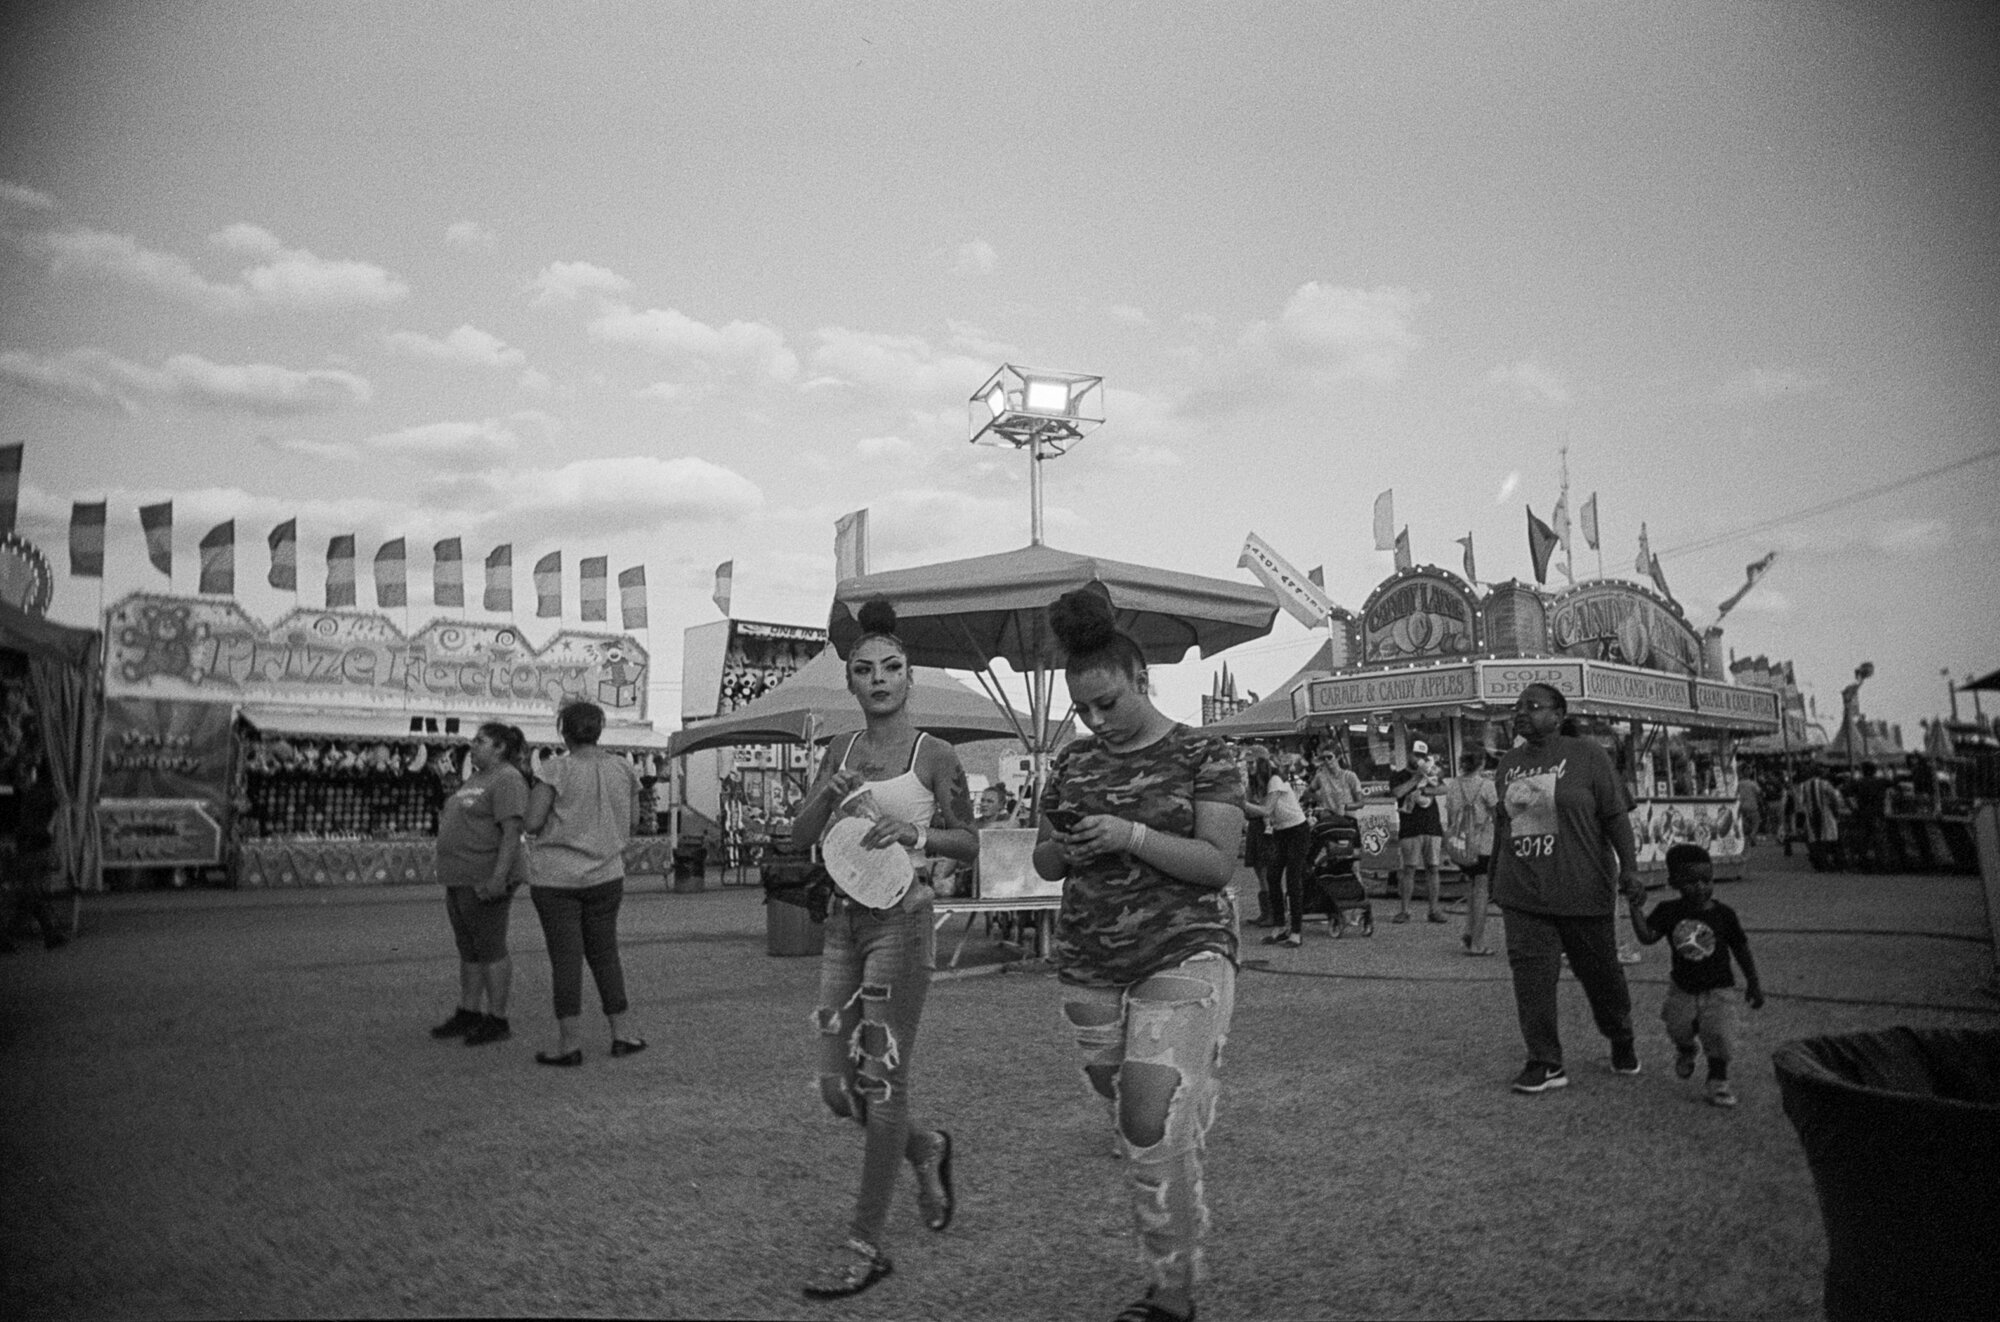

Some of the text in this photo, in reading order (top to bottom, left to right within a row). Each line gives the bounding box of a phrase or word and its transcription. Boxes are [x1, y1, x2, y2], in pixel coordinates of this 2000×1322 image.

[770, 627, 796, 636] ONE
[203, 637, 590, 706] Prize Factory
[1502, 670, 1562, 681] COLD
[1320, 673, 1465, 706] CARMEL & CANDY APPLES
[1490, 682, 1574, 693] DRIS
[1548, 758, 1567, 779] of
[1514, 834, 1555, 858] 2018
